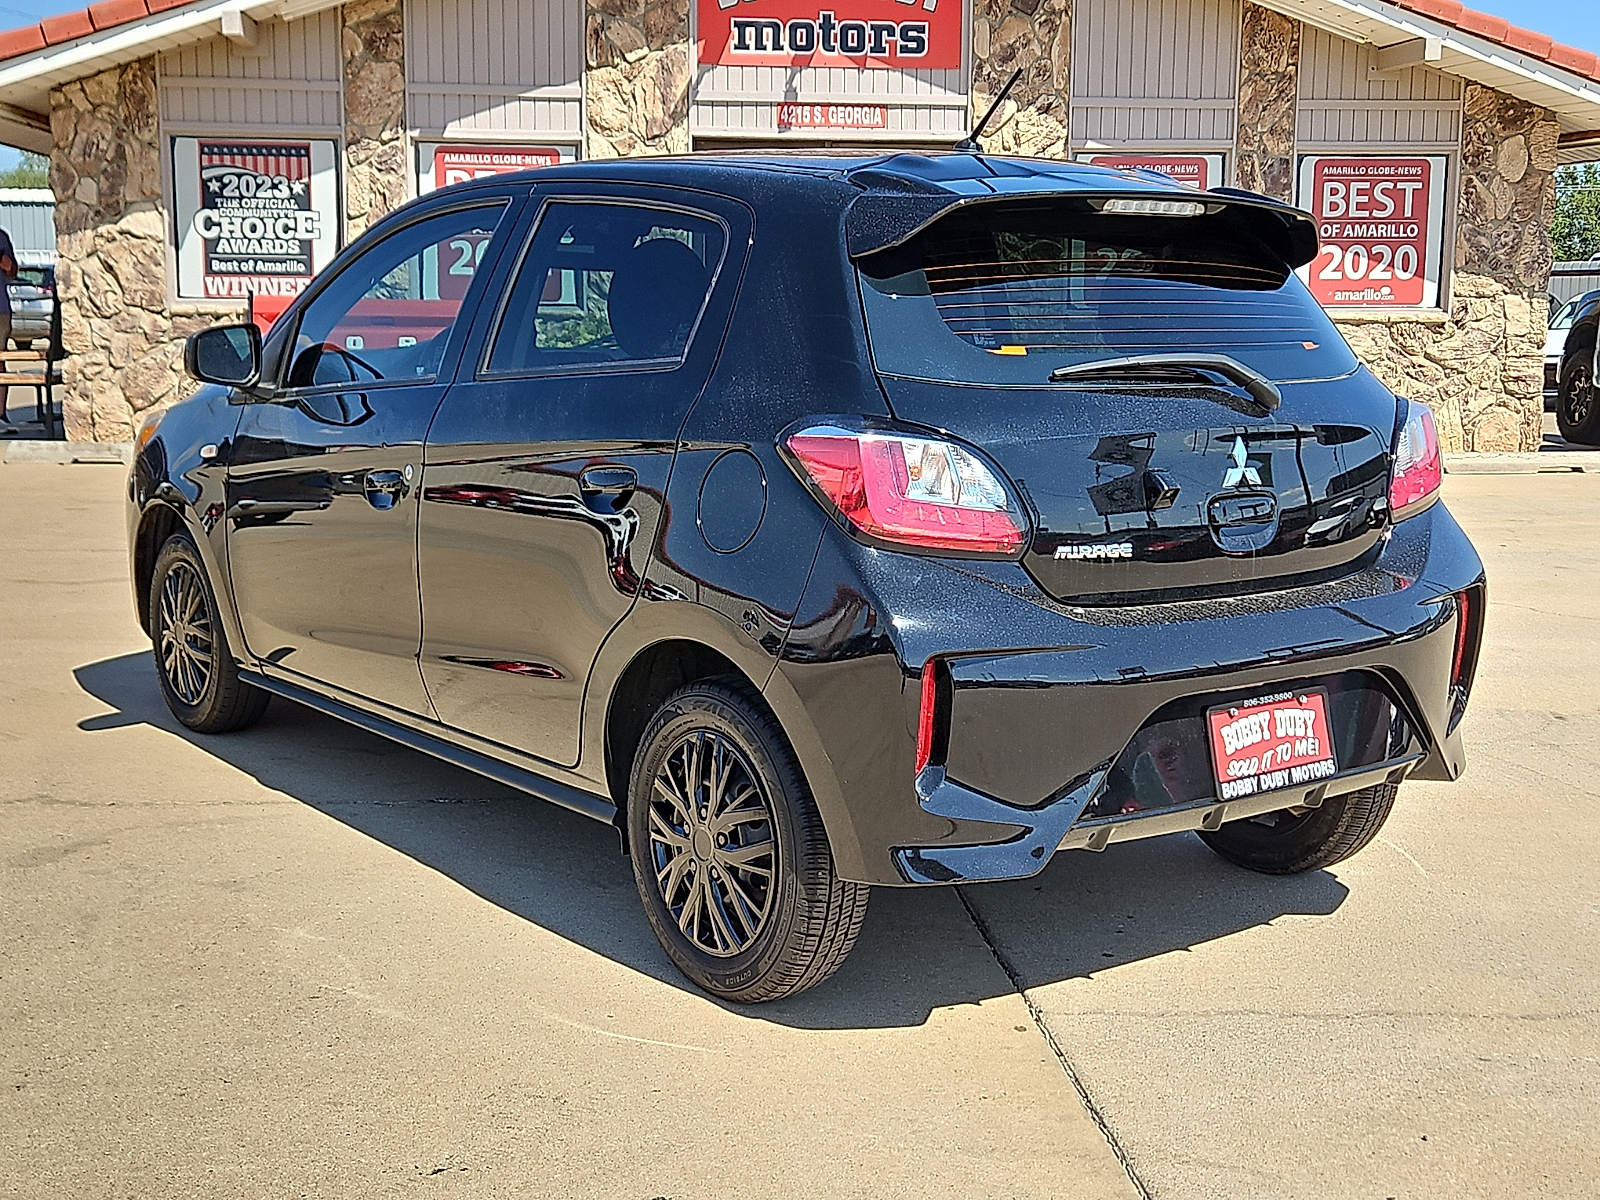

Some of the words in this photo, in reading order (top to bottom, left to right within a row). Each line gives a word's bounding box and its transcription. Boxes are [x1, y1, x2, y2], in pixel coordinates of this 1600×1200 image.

[731, 11, 929, 57] motors
[781, 105, 811, 124] 4215
[814, 106, 826, 123] S.
[829, 106, 882, 125] GEORGIA
[444, 154, 490, 165] AMARILLO
[492, 155, 552, 165] GLOBE-NEWS
[1322, 166, 1366, 175] AMARILLO
[1367, 166, 1423, 175] GLOBE-NEWS
[222, 174, 291, 199] 2023
[215, 198, 240, 208] THE
[242, 198, 298, 209] OFFICIAL
[1322, 181, 1423, 218] BEST
[219, 208, 294, 218] COMMUNITY'S
[193, 208, 321, 240] CHOICE
[1320, 224, 1341, 238] OF
[1342, 223, 1419, 238] AMARILLO
[216, 239, 300, 254] AWARDS
[211, 260, 238, 272] Best
[240, 260, 254, 273] of
[256, 261, 306, 272] Amarillo
[1318, 244, 1418, 281] 2020
[1053, 542, 1134, 560] MIRAGE
[1220, 711, 1271, 756] BOBBY
[1273, 708, 1316, 738] DUBY
[1226, 756, 1259, 777] SOLD
[1261, 749, 1275, 771] IT
[1275, 741, 1292, 764] TO
[1293, 737, 1320, 757] ME!
[1221, 776, 1259, 799] BOBBY
[1260, 766, 1293, 790] DUBY
[1291, 759, 1336, 784] MOTORS
